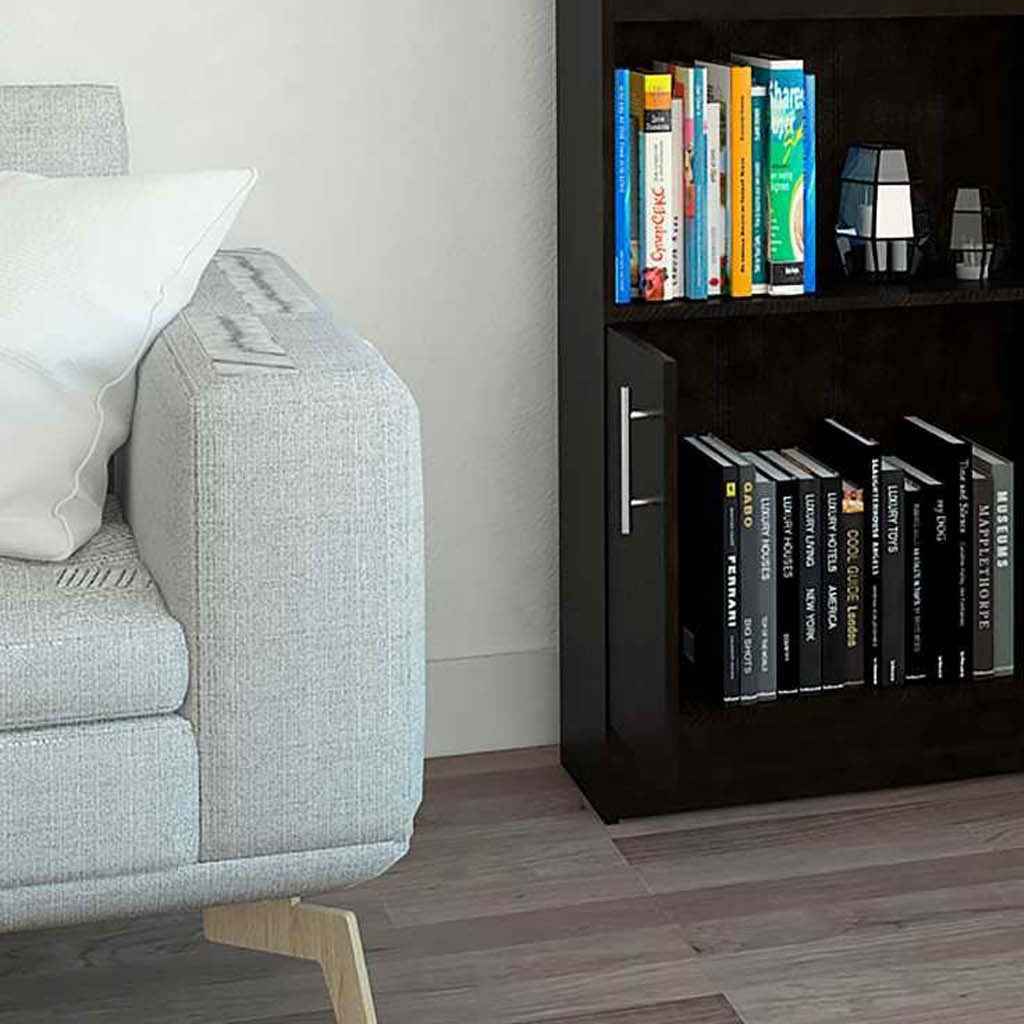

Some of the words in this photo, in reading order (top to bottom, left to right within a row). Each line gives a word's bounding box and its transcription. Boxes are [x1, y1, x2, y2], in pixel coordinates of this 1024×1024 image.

[743, 481, 753, 528] GABO
[804, 493, 815, 533] LUXURY
[827, 492, 838, 531] LUXURY
[871, 458, 880, 538] SLAUGHTERHOUSE
[887, 484, 898, 523] LUXURY
[958, 484, 969, 504] and
[760, 497, 770, 536] LUXURY
[782, 495, 794, 534] LUXURY
[936, 515, 948, 542] DOG
[996, 490, 1008, 568] MUSEUMS
[760, 537, 771, 581] HOUSES
[783, 536, 794, 579] HOUSES
[804, 535, 815, 567] LIVING
[827, 533, 838, 573] HOTELS
[846, 528, 859, 562] COOL
[887, 526, 898, 554] TOYS
[846, 565, 859, 602] GUIDE
[978, 504, 990, 631] MAPPLETHORPE
[727, 555, 737, 627] FERRARI
[805, 589, 816, 611] NEW
[827, 584, 838, 630] AMERICA
[744, 617, 752, 638] BIG
[805, 613, 816, 643] YORK
[846, 605, 859, 649] London
[744, 639, 752, 674] SHOTS
